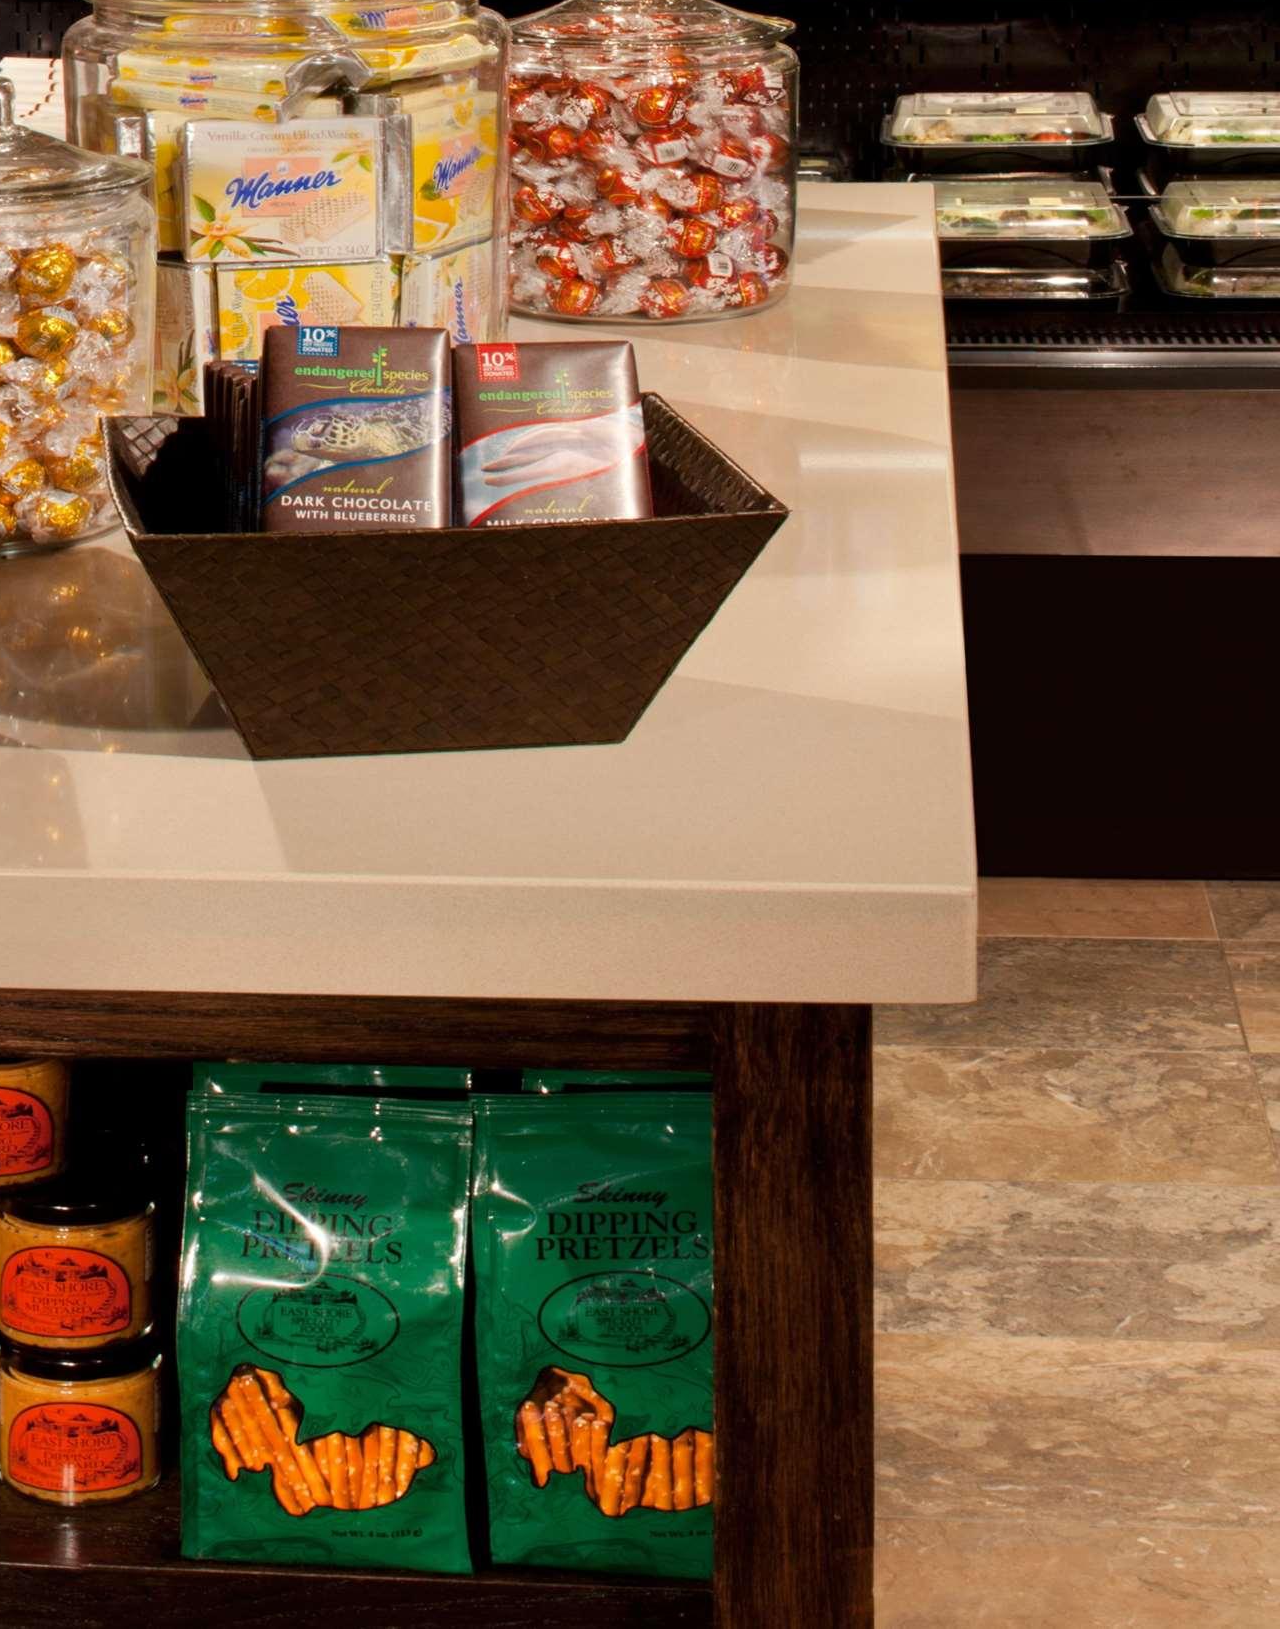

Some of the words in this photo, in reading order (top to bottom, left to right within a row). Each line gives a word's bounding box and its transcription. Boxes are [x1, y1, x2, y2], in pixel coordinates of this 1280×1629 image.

[208, 130, 246, 142] Vanilla
[434, 146, 481, 190] Manner
[226, 169, 342, 209] Manner
[303, 328, 337, 343] 10%
[303, 346, 334, 354] DONATED
[481, 352, 515, 368] 10%
[295, 366, 376, 380] endangered
[383, 370, 429, 382] species
[323, 476, 394, 494] natural
[281, 495, 325, 508] DARK
[332, 496, 434, 513] CHOCOLATE
[296, 509, 329, 520] WITH
[334, 511, 417, 523] BLUEBERRIES
[283, 1182, 369, 1210] Skinny
[572, 1183, 670, 1207] Skinny
[254, 1210, 394, 1239] DIPPING
[548, 1210, 698, 1237] DIPPING
[535, 1236, 710, 1263] PRETZELS
